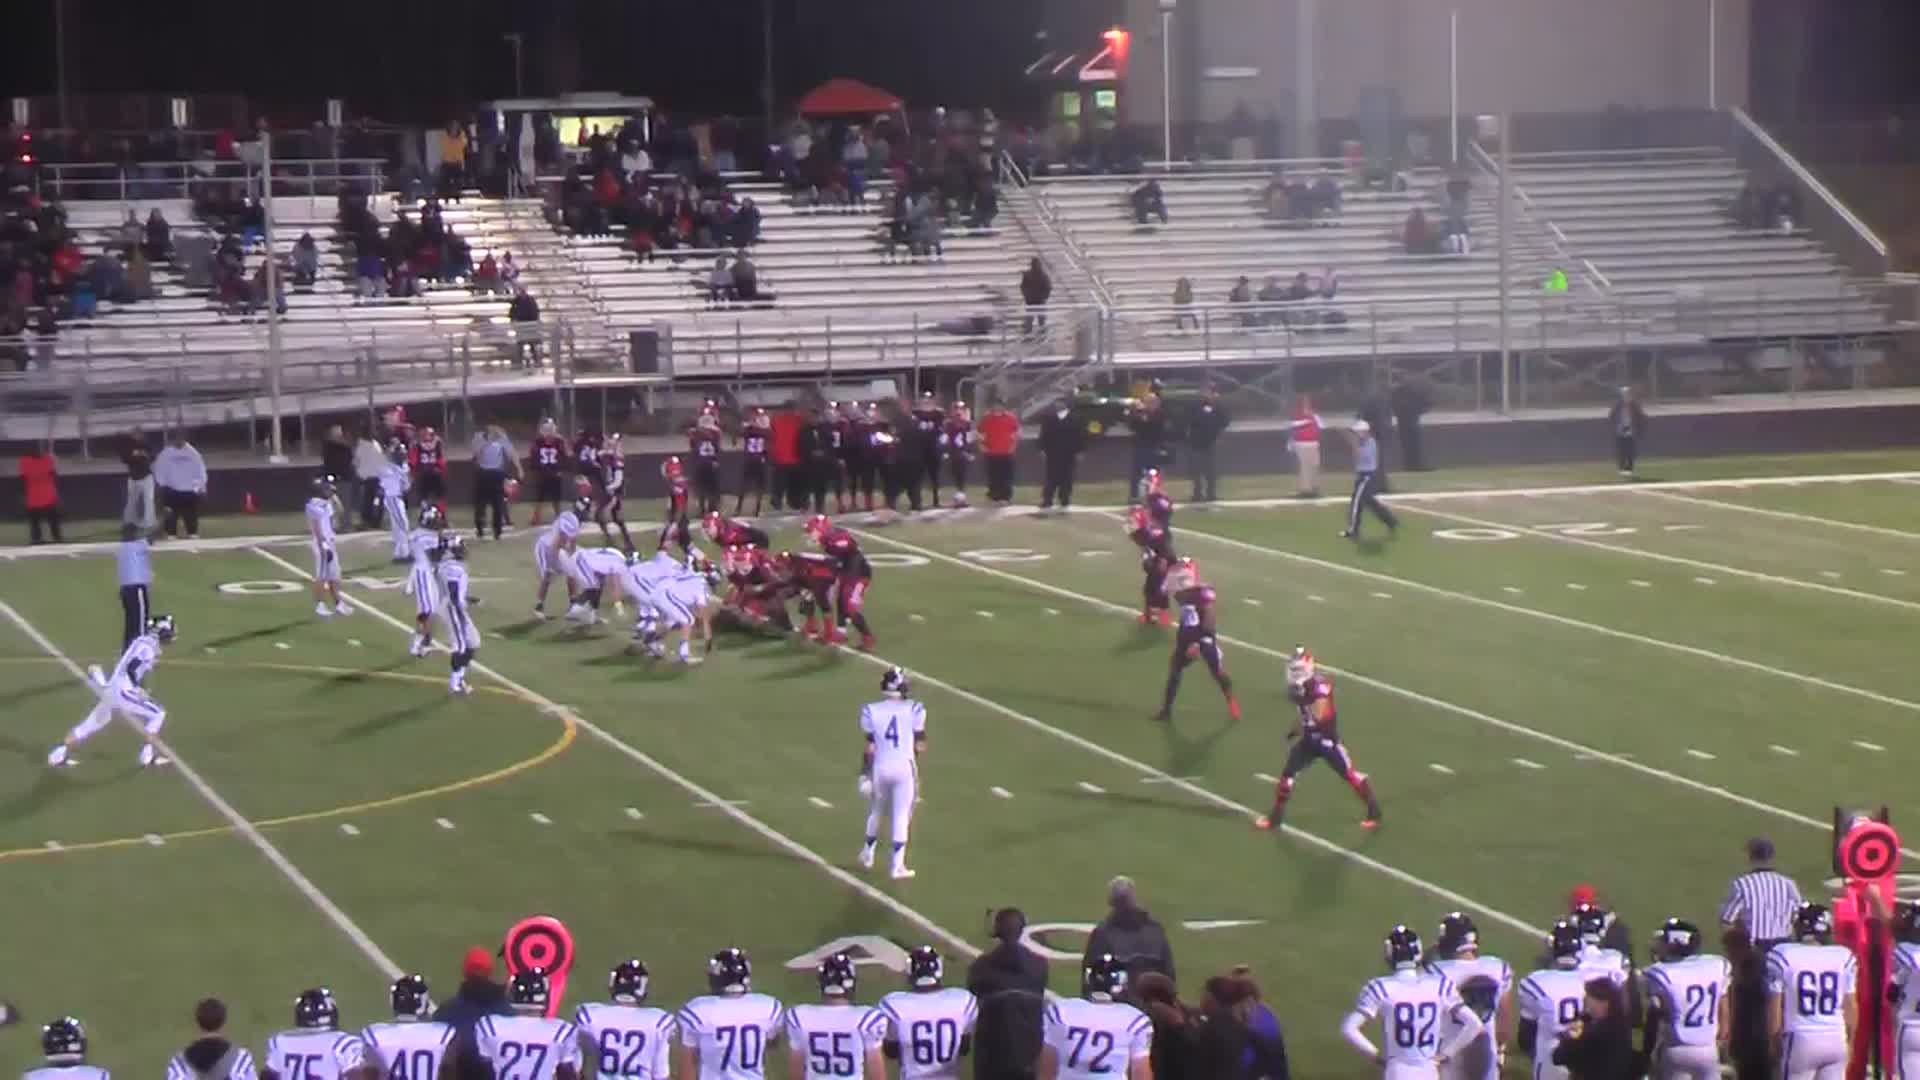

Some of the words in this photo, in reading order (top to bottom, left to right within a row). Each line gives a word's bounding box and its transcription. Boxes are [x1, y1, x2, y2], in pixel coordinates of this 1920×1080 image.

[884, 714, 899, 749] 4
[1683, 981, 1718, 1028] 21
[1797, 970, 1839, 1016] 68
[715, 1024, 761, 1071] 70
[910, 1018, 958, 1065] 60
[1393, 1001, 1438, 1048] 82
[390, 1049, 434, 1080] 40
[499, 1041, 549, 1080] 27
[599, 1028, 647, 1076] 62
[808, 1031, 855, 1077] 55
[1067, 1026, 1115, 1073] 72
